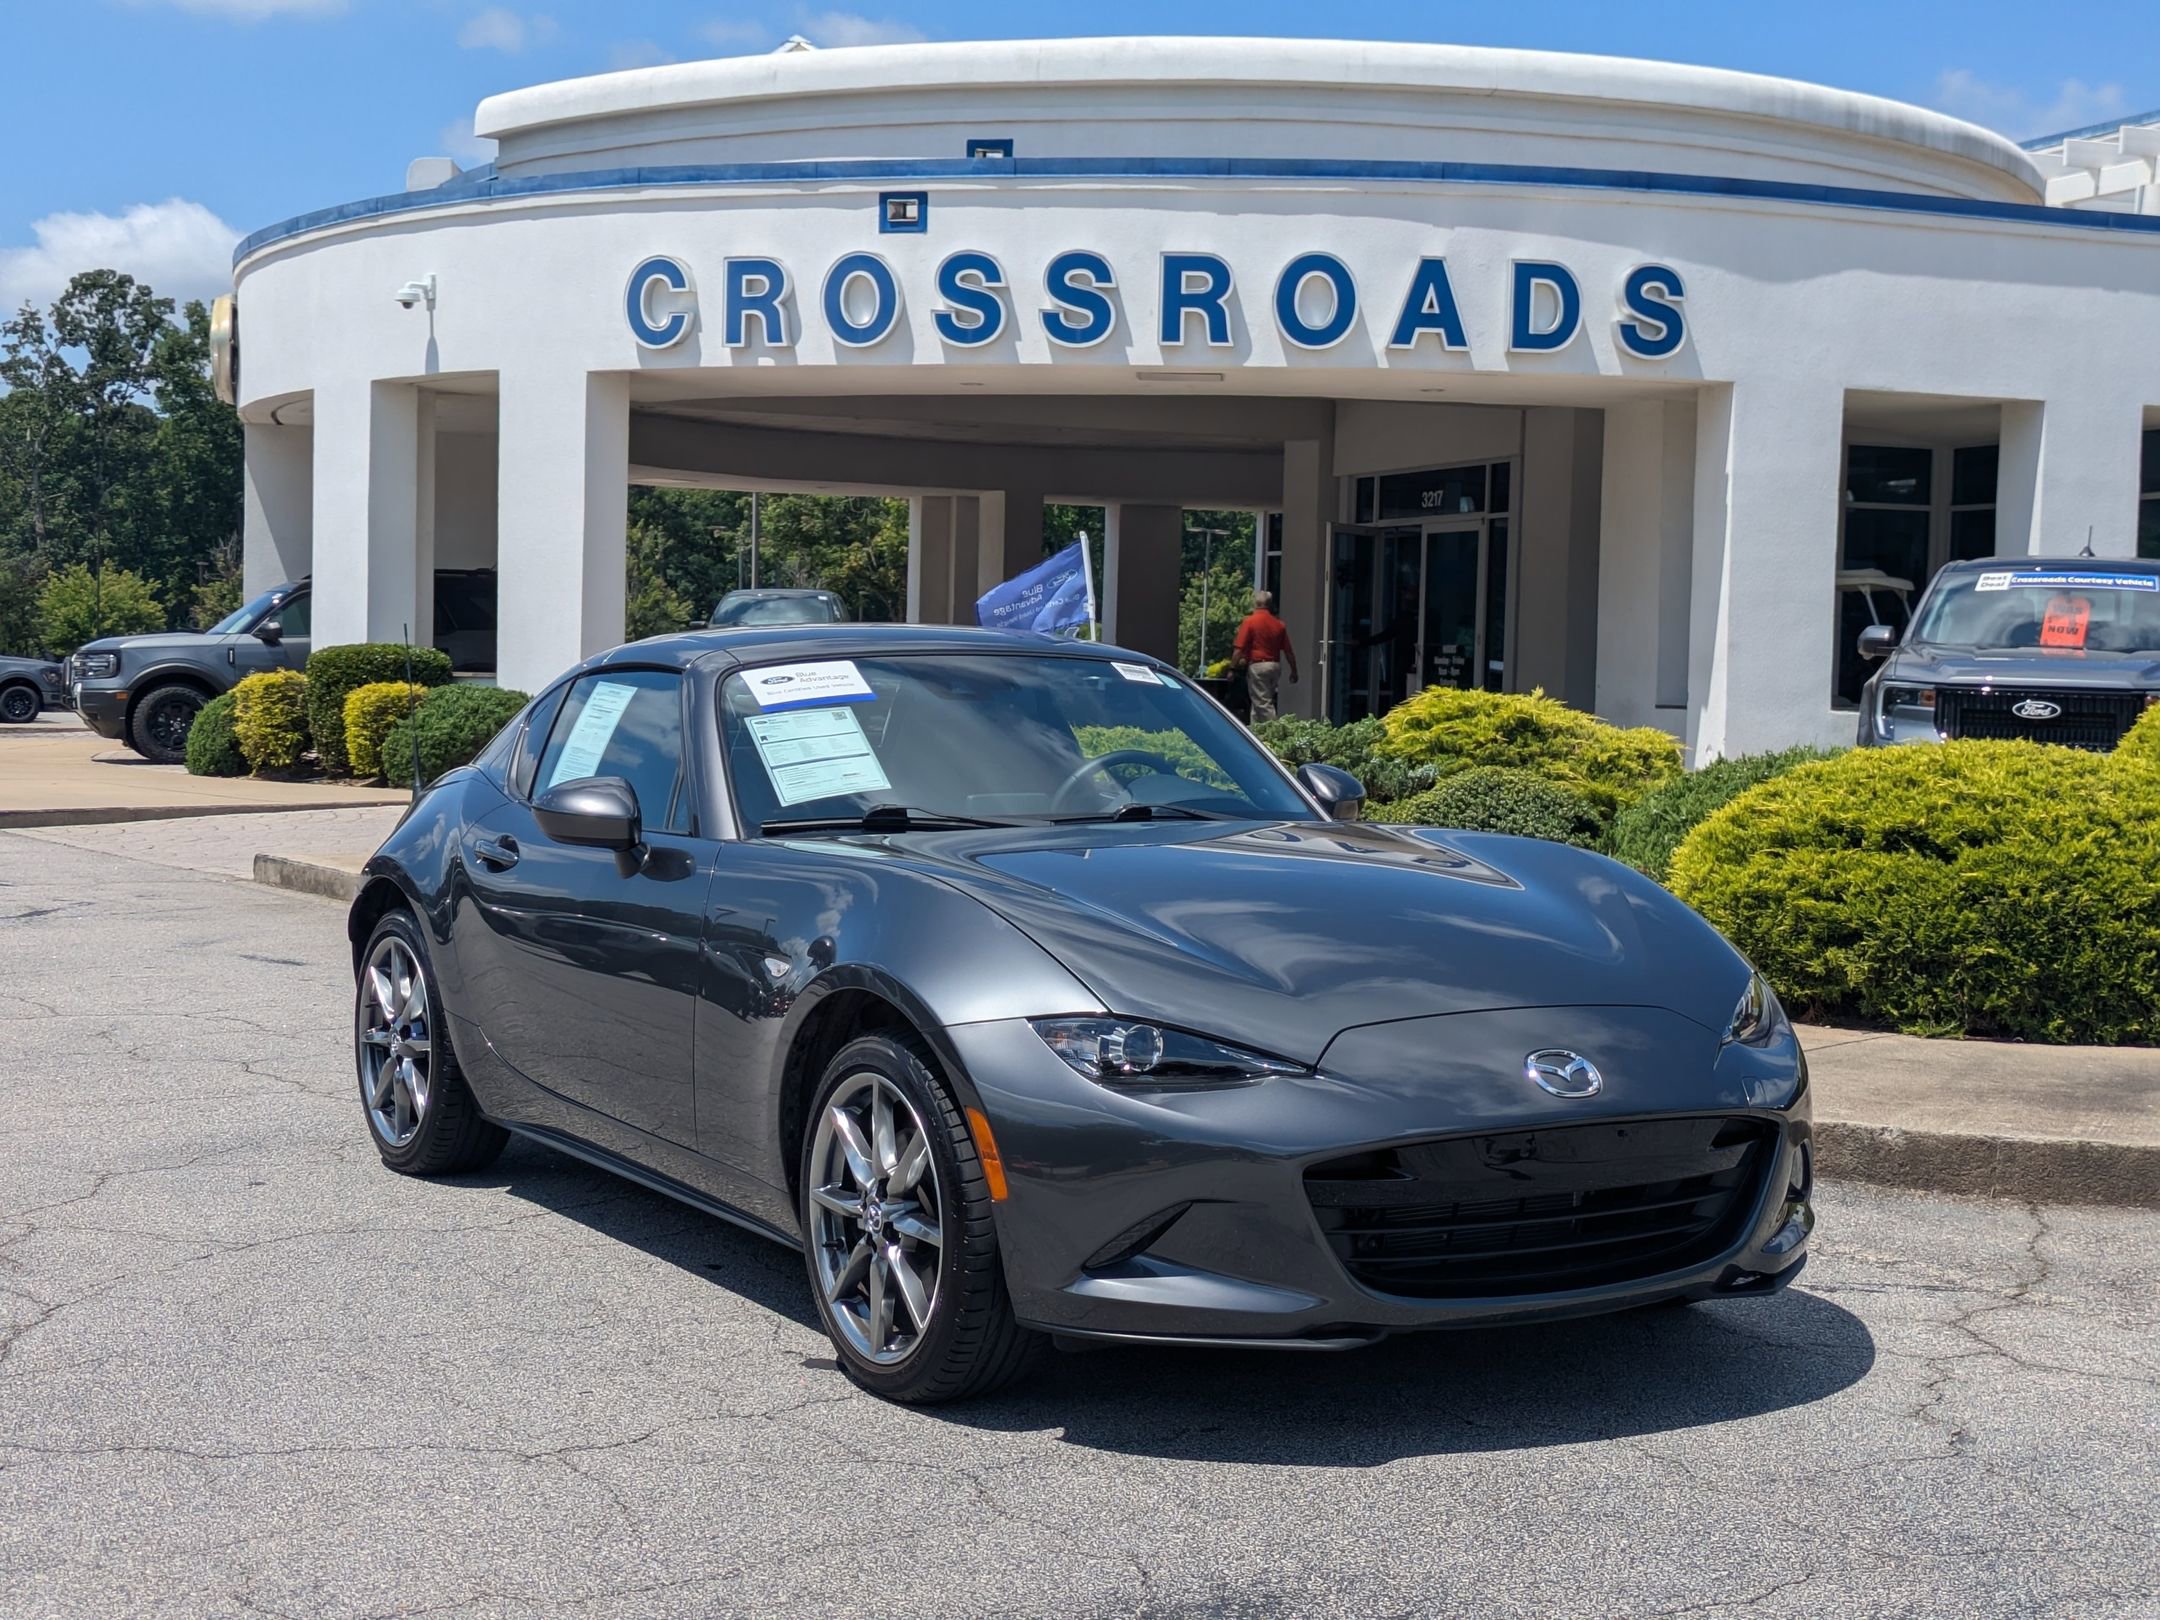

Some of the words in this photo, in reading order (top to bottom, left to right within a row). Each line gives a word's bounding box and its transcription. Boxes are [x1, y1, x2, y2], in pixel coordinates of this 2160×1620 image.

[625, 251, 1686, 360] CROSSROADS
[1421, 490, 1443, 508] 3217
[2011, 576, 2067, 584] Crossroads
[2068, 576, 2113, 586] Courtesy
[2115, 578, 2154, 587] Vehicle
[800, 674, 849, 683] Advantage
[2020, 703, 2053, 716] Ford
